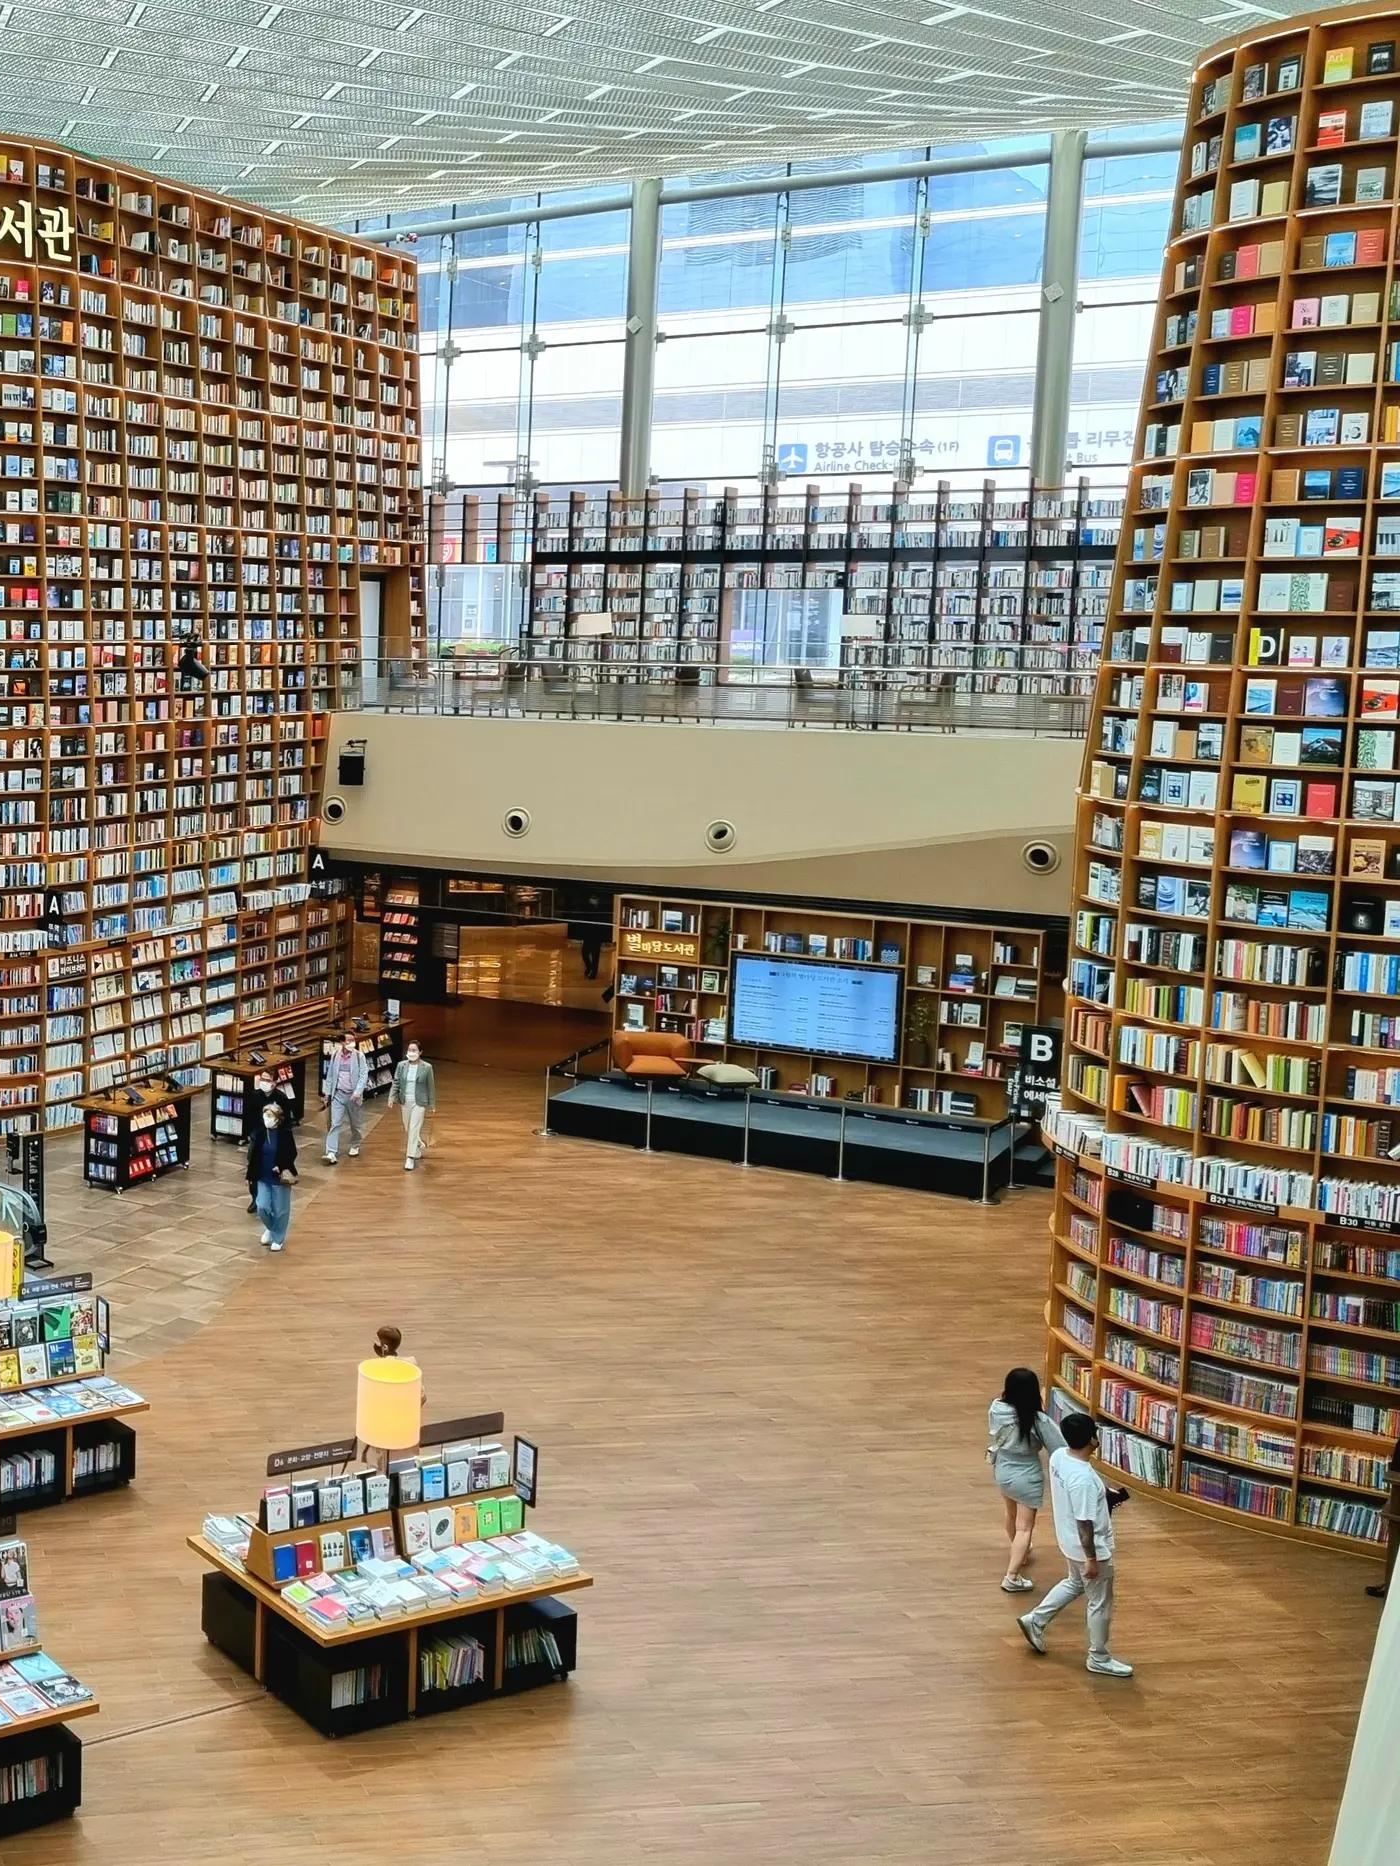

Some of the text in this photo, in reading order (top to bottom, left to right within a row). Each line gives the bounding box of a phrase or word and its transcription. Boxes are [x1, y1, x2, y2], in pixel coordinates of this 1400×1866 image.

[815, 441, 863, 459] 항공사
[869, 439, 935, 457] 탑승속
[814, 458, 901, 472] Airline Check-i
[1076, 452, 1098, 463] Bus
[1258, 635, 1276, 657] D
[312, 853, 324, 870] A
[49, 895, 59, 915] A
[1030, 1034, 1053, 1062] B
[1024, 1075, 1056, 1089] 비소설
[1210, 1194, 1226, 1204] B29
[1339, 1216, 1358, 1227] B30
